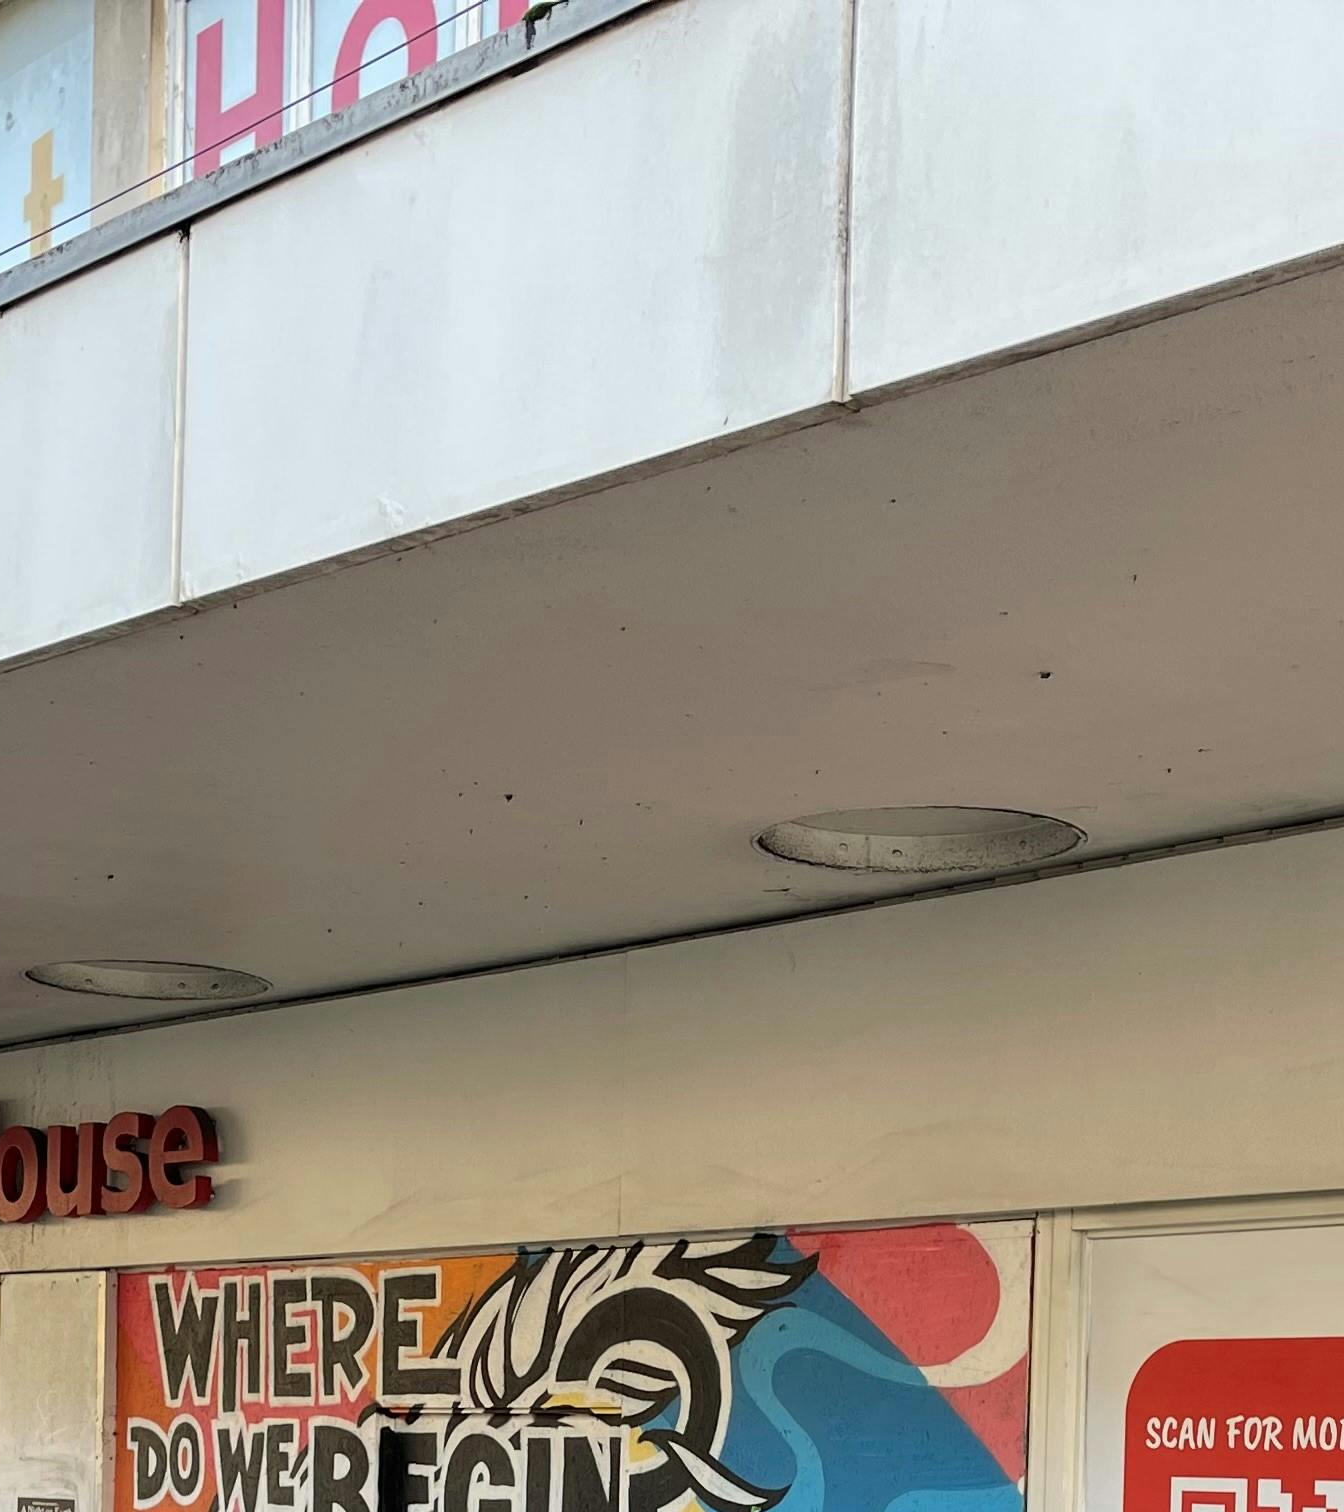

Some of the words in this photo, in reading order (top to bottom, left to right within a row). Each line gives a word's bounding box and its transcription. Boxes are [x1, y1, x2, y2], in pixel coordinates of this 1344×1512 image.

[152, 1270, 464, 1406] WHERE
[131, 1416, 201, 1509] DO
[1145, 1416, 1216, 1450] SCAN
[1226, 1415, 1284, 1451] FOR
